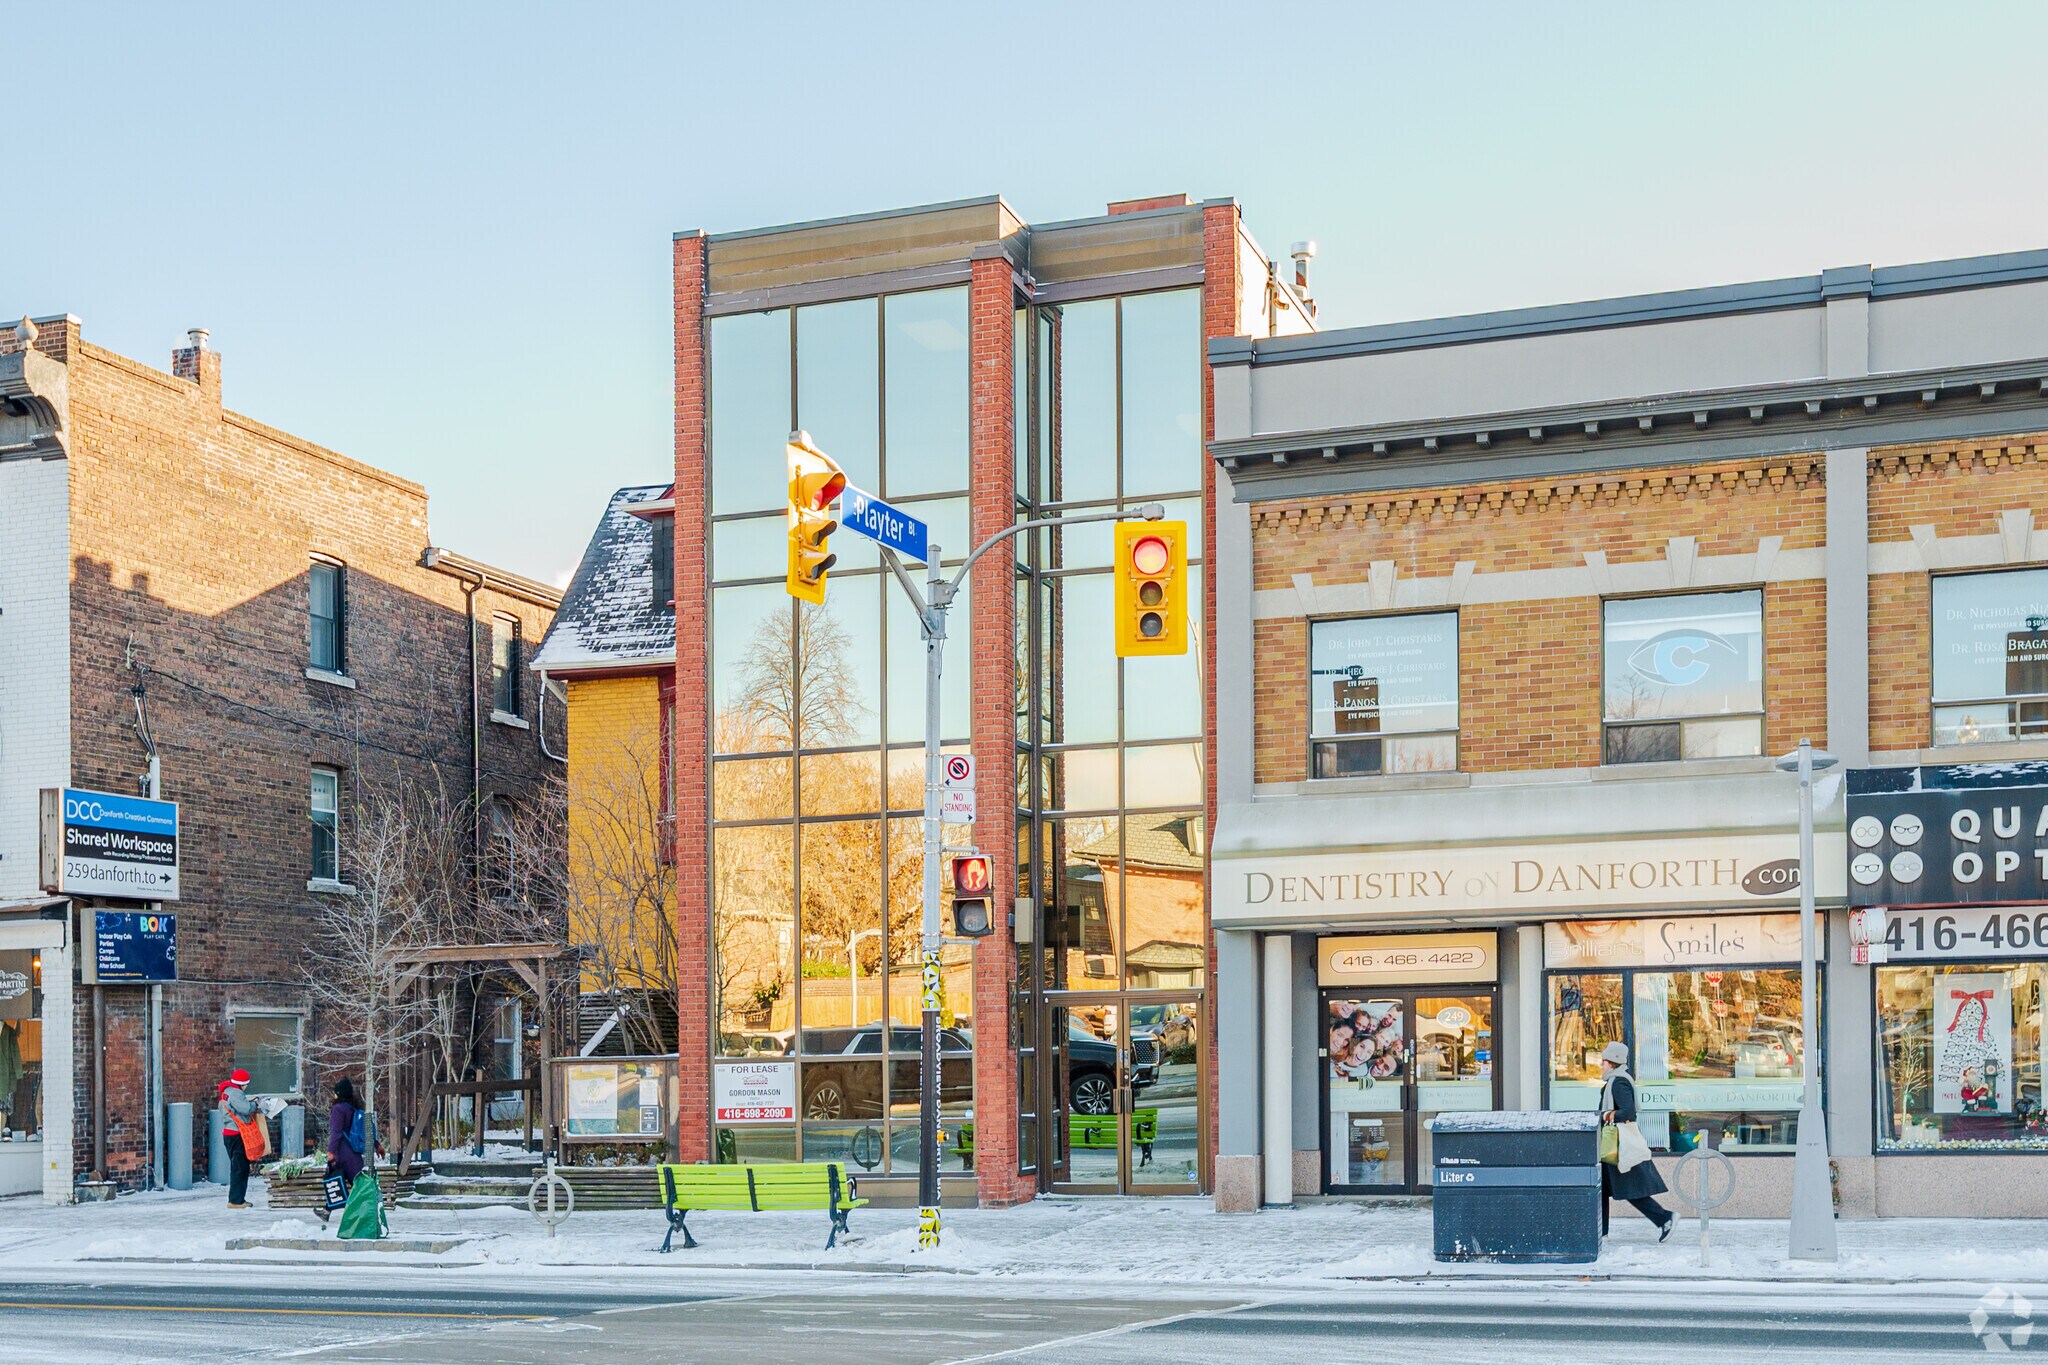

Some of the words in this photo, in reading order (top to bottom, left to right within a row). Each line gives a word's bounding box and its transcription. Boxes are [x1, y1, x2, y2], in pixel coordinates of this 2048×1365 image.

[856, 495, 904, 542] Playter
[1969, 606, 2027, 619] NICHOLAS
[1347, 637, 1371, 649] JOHN
[1373, 636, 1385, 647] T.
[1386, 633, 1442, 646] CHRISTAKIS
[1974, 641, 2006, 653] ROSA
[2019, 654, 2033, 662] AND
[1397, 662, 1447, 674] CHRISTAKIS
[1347, 679, 1357, 687] EYE
[1357, 677, 1386, 687] PHYSICIAN
[1343, 697, 1376, 708] PANOS
[1390, 693, 1448, 706] CHRISTAKIS
[1347, 712, 1358, 720] EYE
[1358, 710, 1386, 720] PHYSICIAN
[953, 793, 964, 801] NO
[66, 799, 102, 822] DCC
[100, 808, 124, 820] Danforth
[124, 812, 147, 822] Creative
[944, 803, 973, 812] STANDING
[66, 828, 109, 848] Shared
[110, 832, 173, 855] Workspace
[67, 862, 157, 885] 259danforth.to
[1243, 869, 1454, 905] DENTISTRY
[1464, 871, 1501, 898] ON
[1511, 858, 1741, 894] DANFORTH
[139, 916, 168, 933] BOK
[1548, 938, 1645, 959] Brilliant
[1659, 921, 1745, 964] Smiles
[1444, 1011, 1464, 1022] 249
[731, 1066, 749, 1074] FOR
[751, 1065, 779, 1073] LEASE
[728, 1089, 756, 1097] GORDON
[757, 1088, 781, 1096] MASON
[1726, 1090, 1797, 1103] DANFORTH
[724, 1108, 786, 1119] 416-698-2090
[1440, 1171, 1465, 1183] Litter
